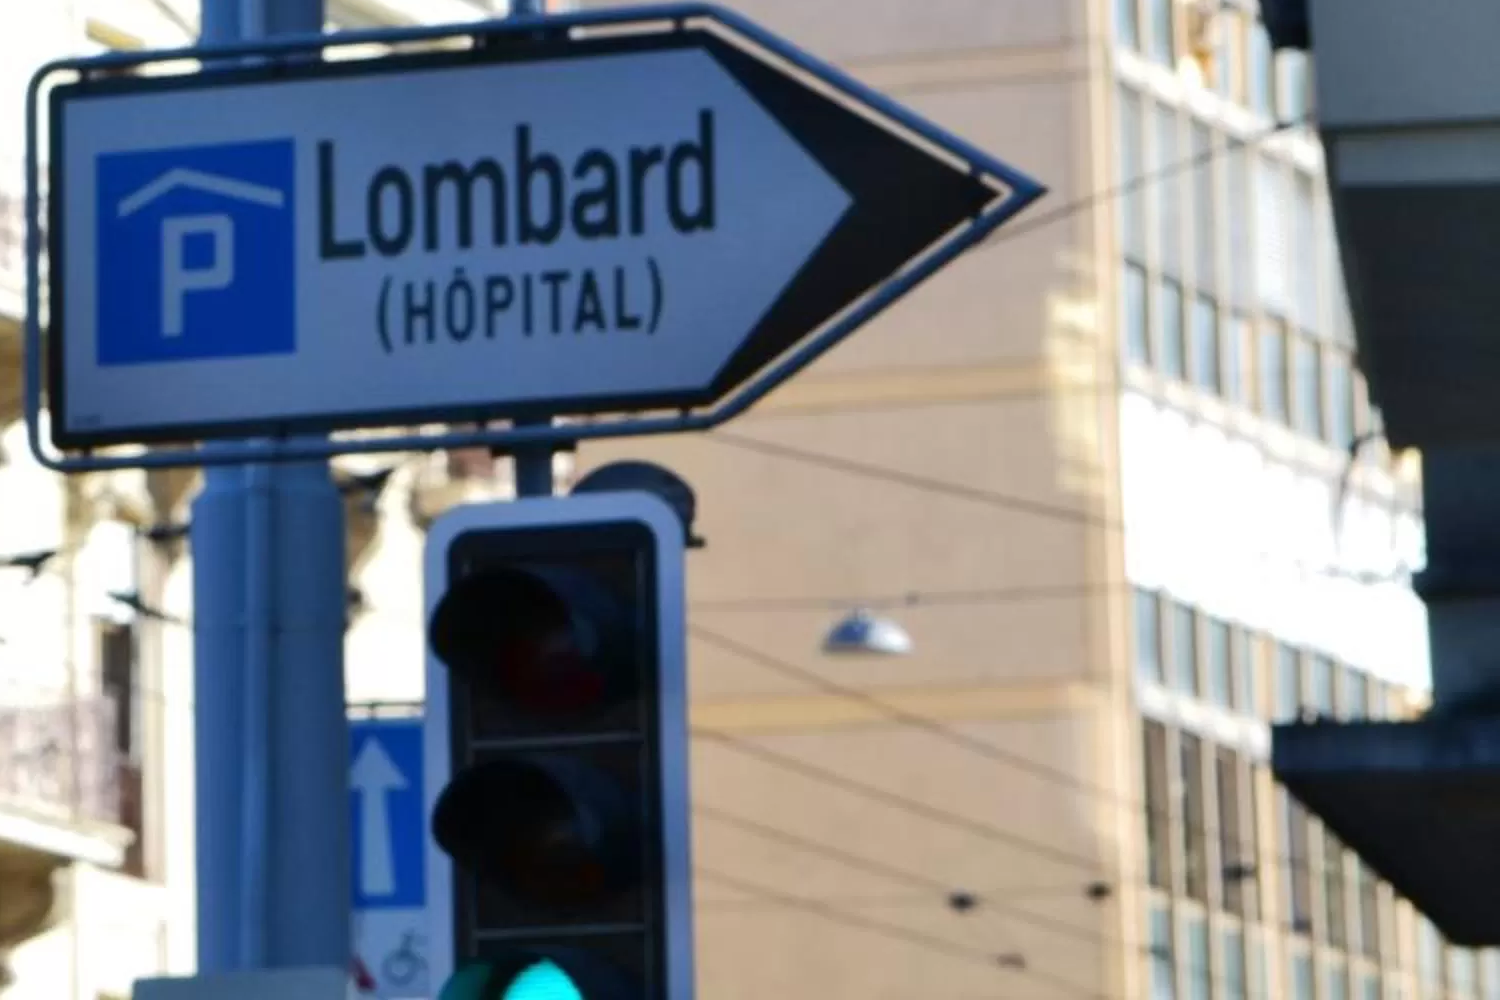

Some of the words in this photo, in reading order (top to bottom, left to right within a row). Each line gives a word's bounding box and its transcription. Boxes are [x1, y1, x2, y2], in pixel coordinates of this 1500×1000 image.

[316, 107, 715, 261] Lombard
[160, 213, 235, 338] P
[375, 256, 663, 354] (HÔPITAL)
